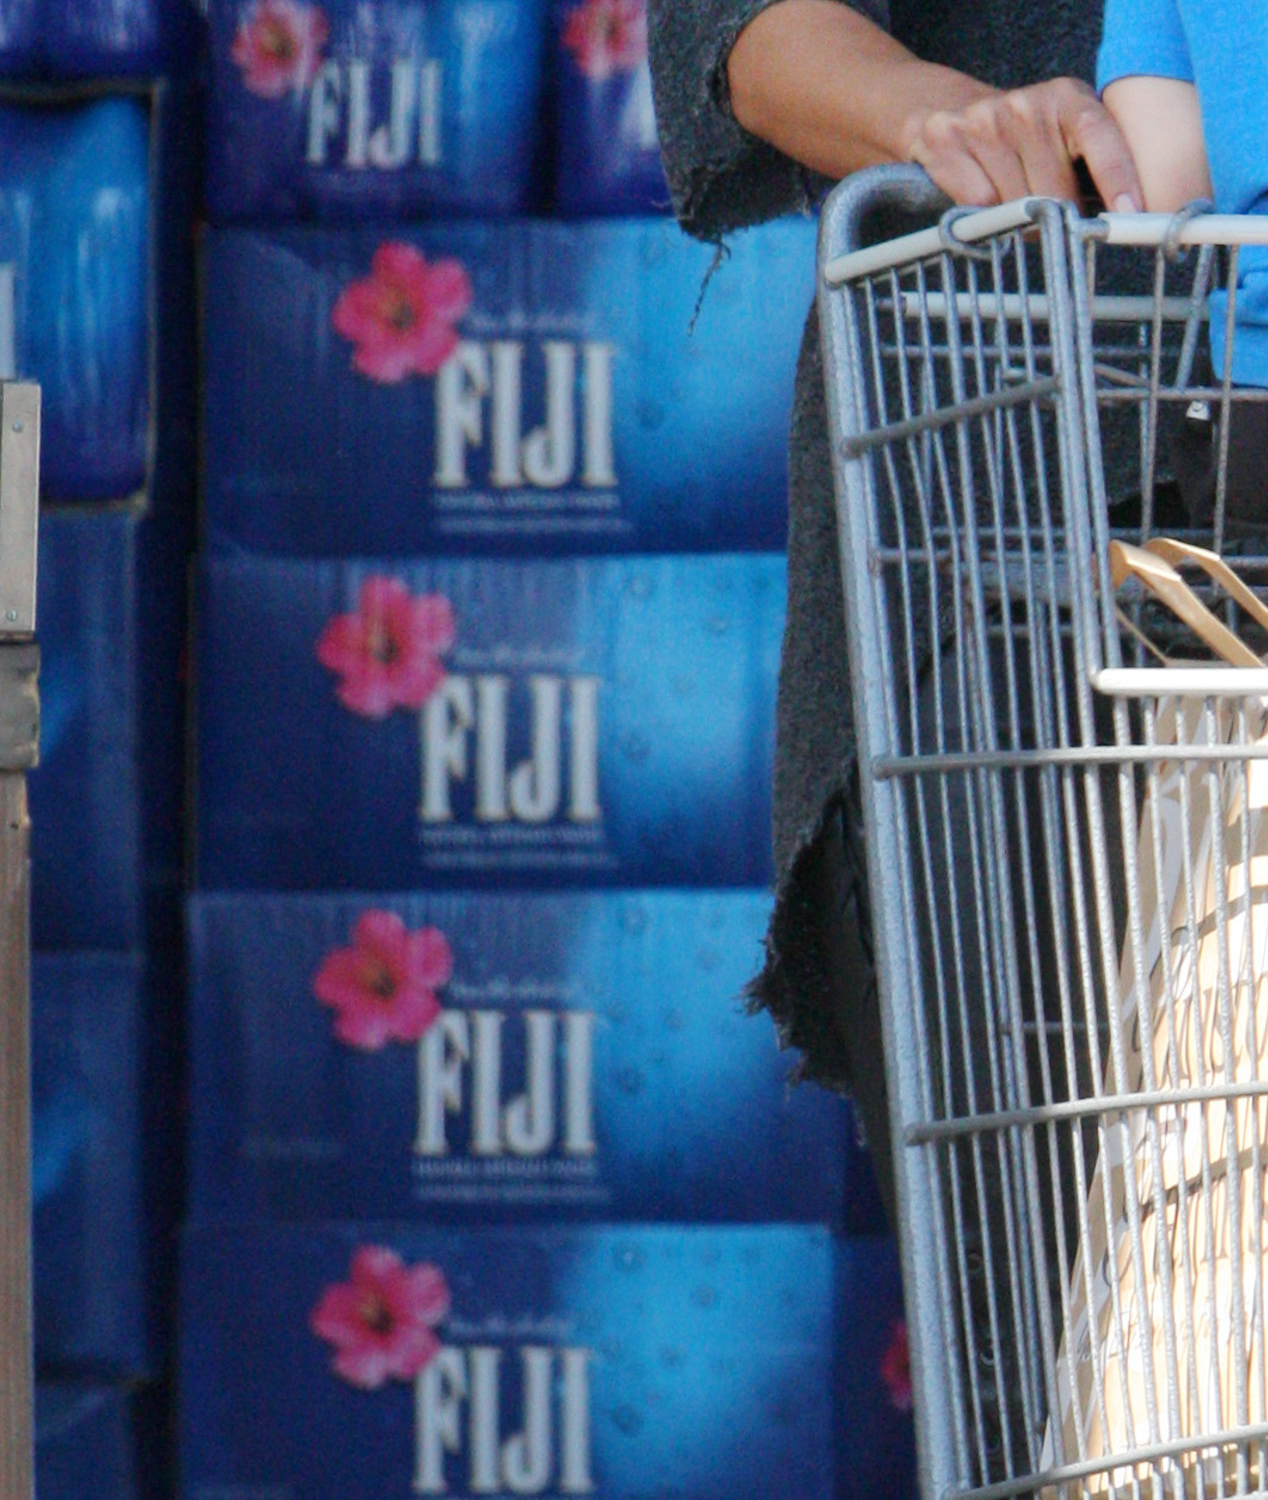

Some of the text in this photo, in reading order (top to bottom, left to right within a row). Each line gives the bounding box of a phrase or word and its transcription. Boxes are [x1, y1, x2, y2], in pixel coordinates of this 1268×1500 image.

[305, 59, 442, 169] FIJI
[431, 340, 619, 488] FIJI
[417, 673, 602, 824] FIJI
[413, 1008, 598, 1158] FIJI
[411, 1345, 594, 1495] FIJI
